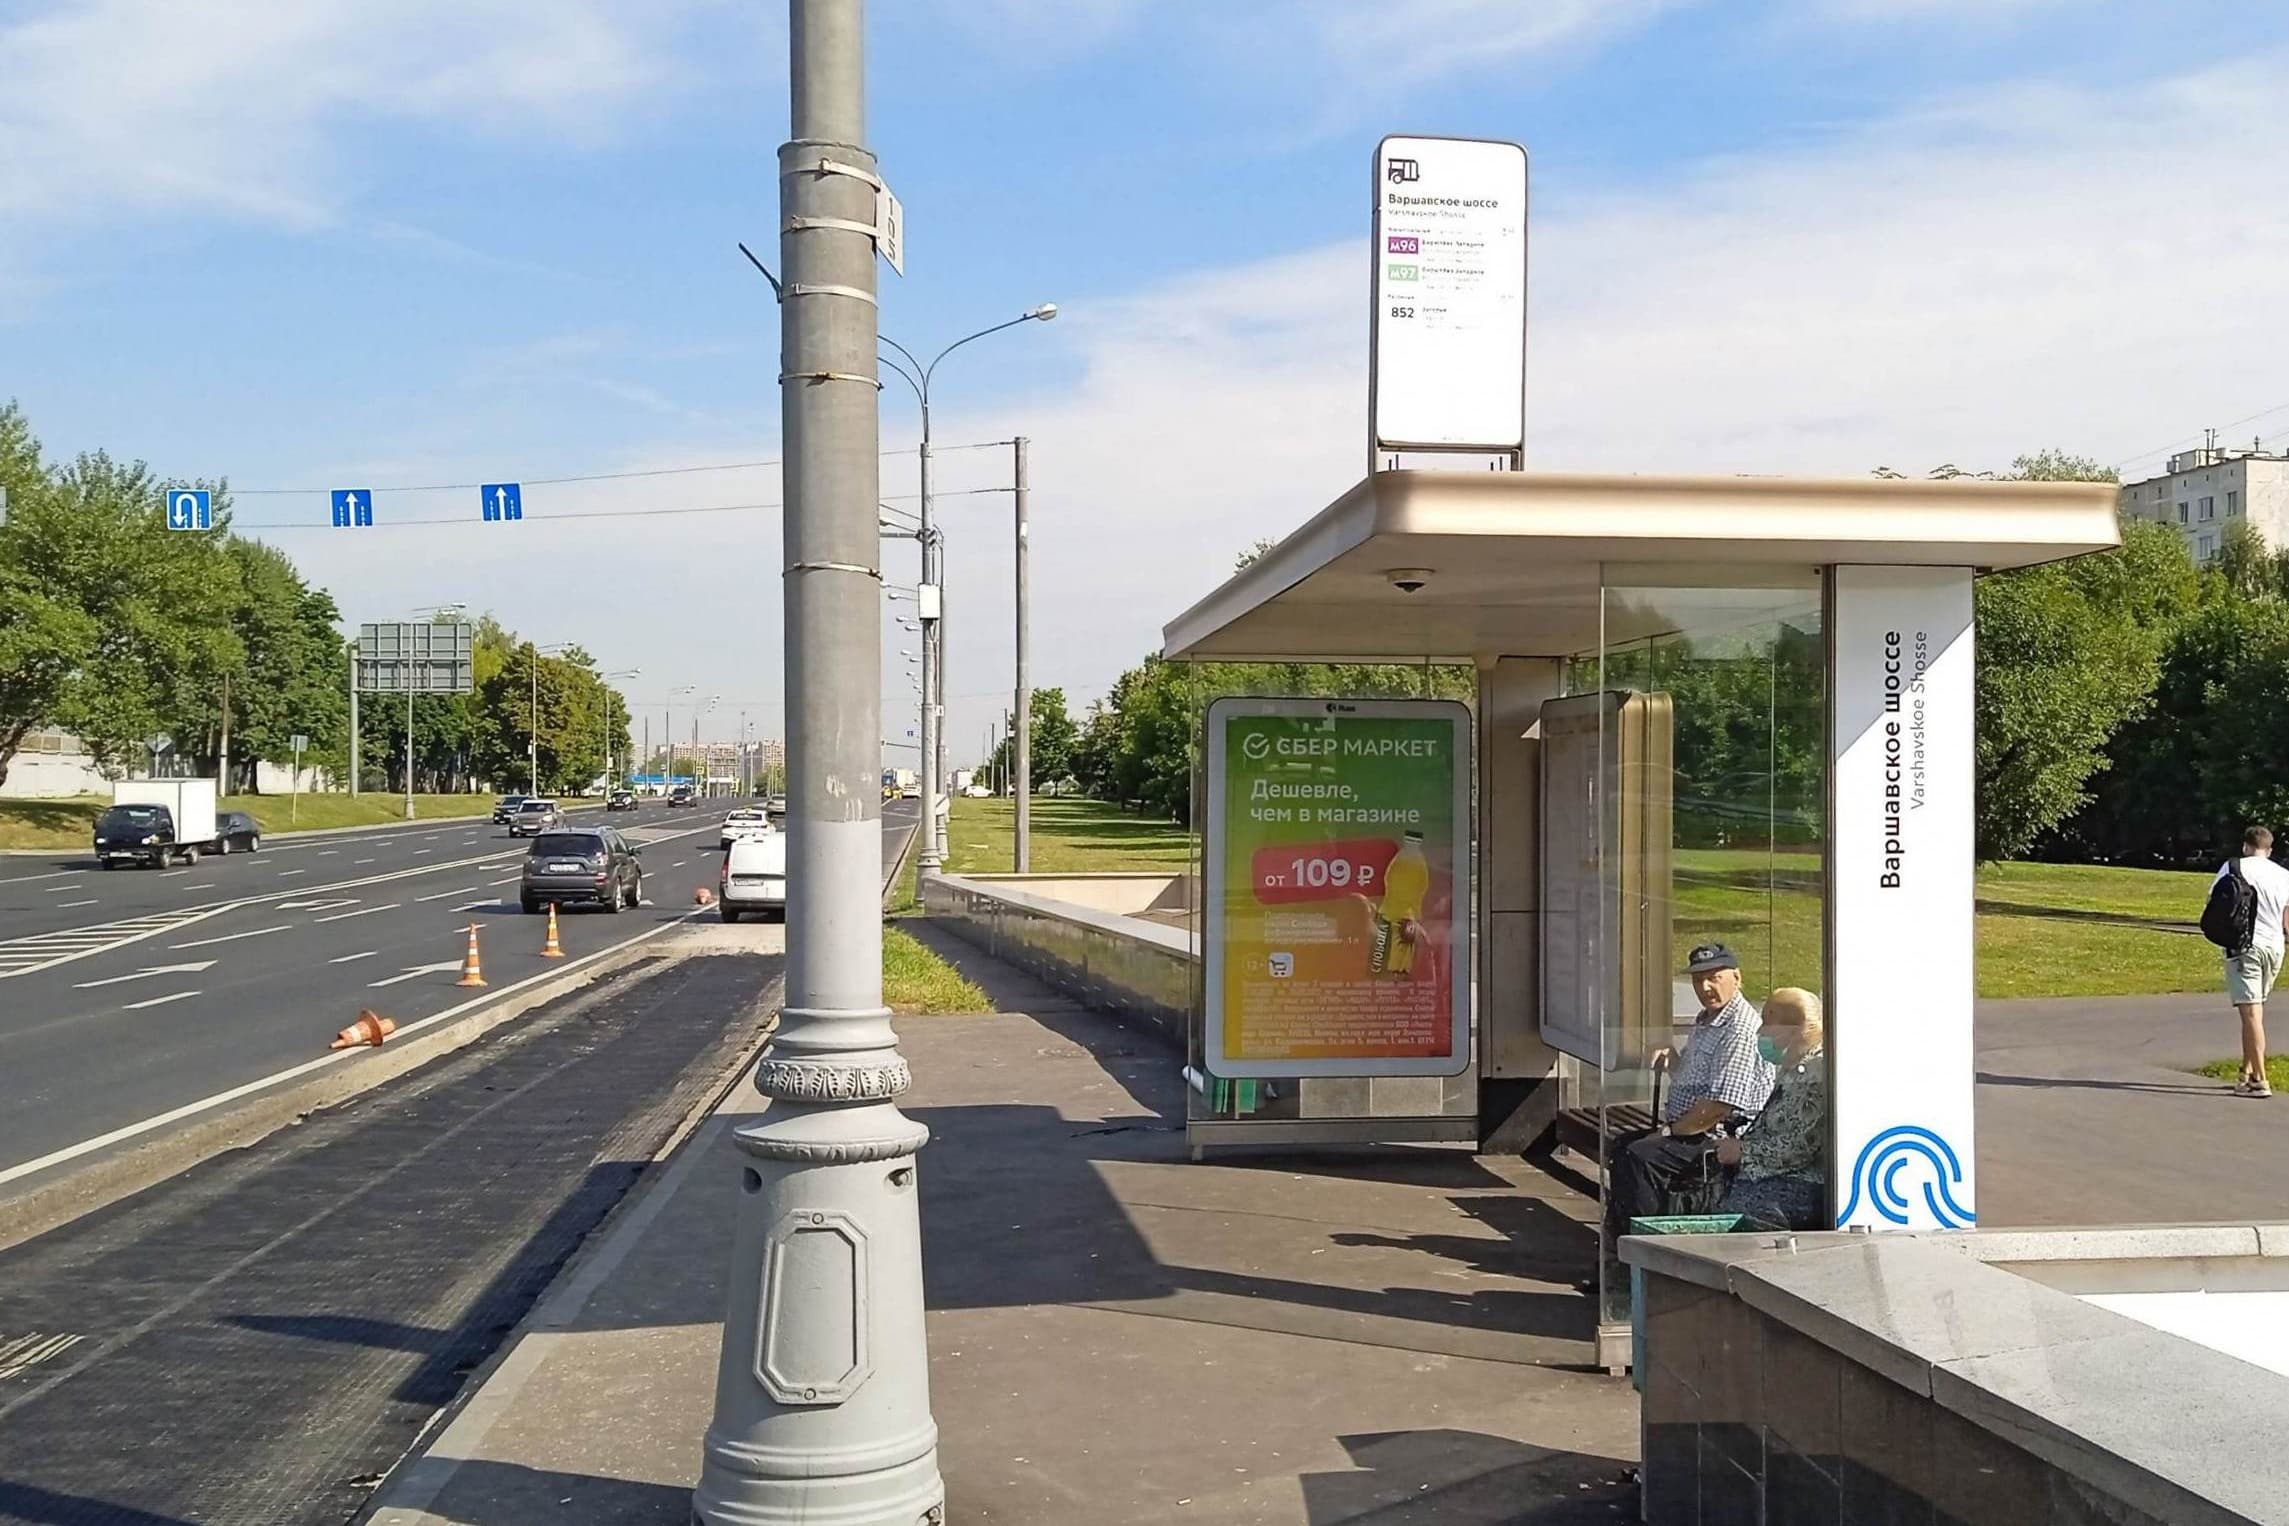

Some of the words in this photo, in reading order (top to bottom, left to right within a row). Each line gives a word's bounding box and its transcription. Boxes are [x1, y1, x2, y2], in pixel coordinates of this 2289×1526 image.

[1388, 193, 1460, 207] Варшавское
[1463, 199, 1499, 208] шоссе
[1391, 307, 1415, 319] 852
[1884, 631, 1901, 712] шоссе
[1909, 631, 1928, 694] Shosse
[1276, 737, 1338, 755] СБЕР
[1344, 738, 1437, 757] МАРКЕТ
[1909, 699, 1926, 810] Varshavskoe
[1250, 779, 1359, 802] Дешевле,
[1250, 807, 1291, 822] чем
[1299, 808, 1311, 822] в
[1317, 808, 1421, 823] магазине
[1880, 721, 1905, 889] Варшавское
[1264, 875, 1286, 887] от
[1291, 858, 1351, 887] 109
